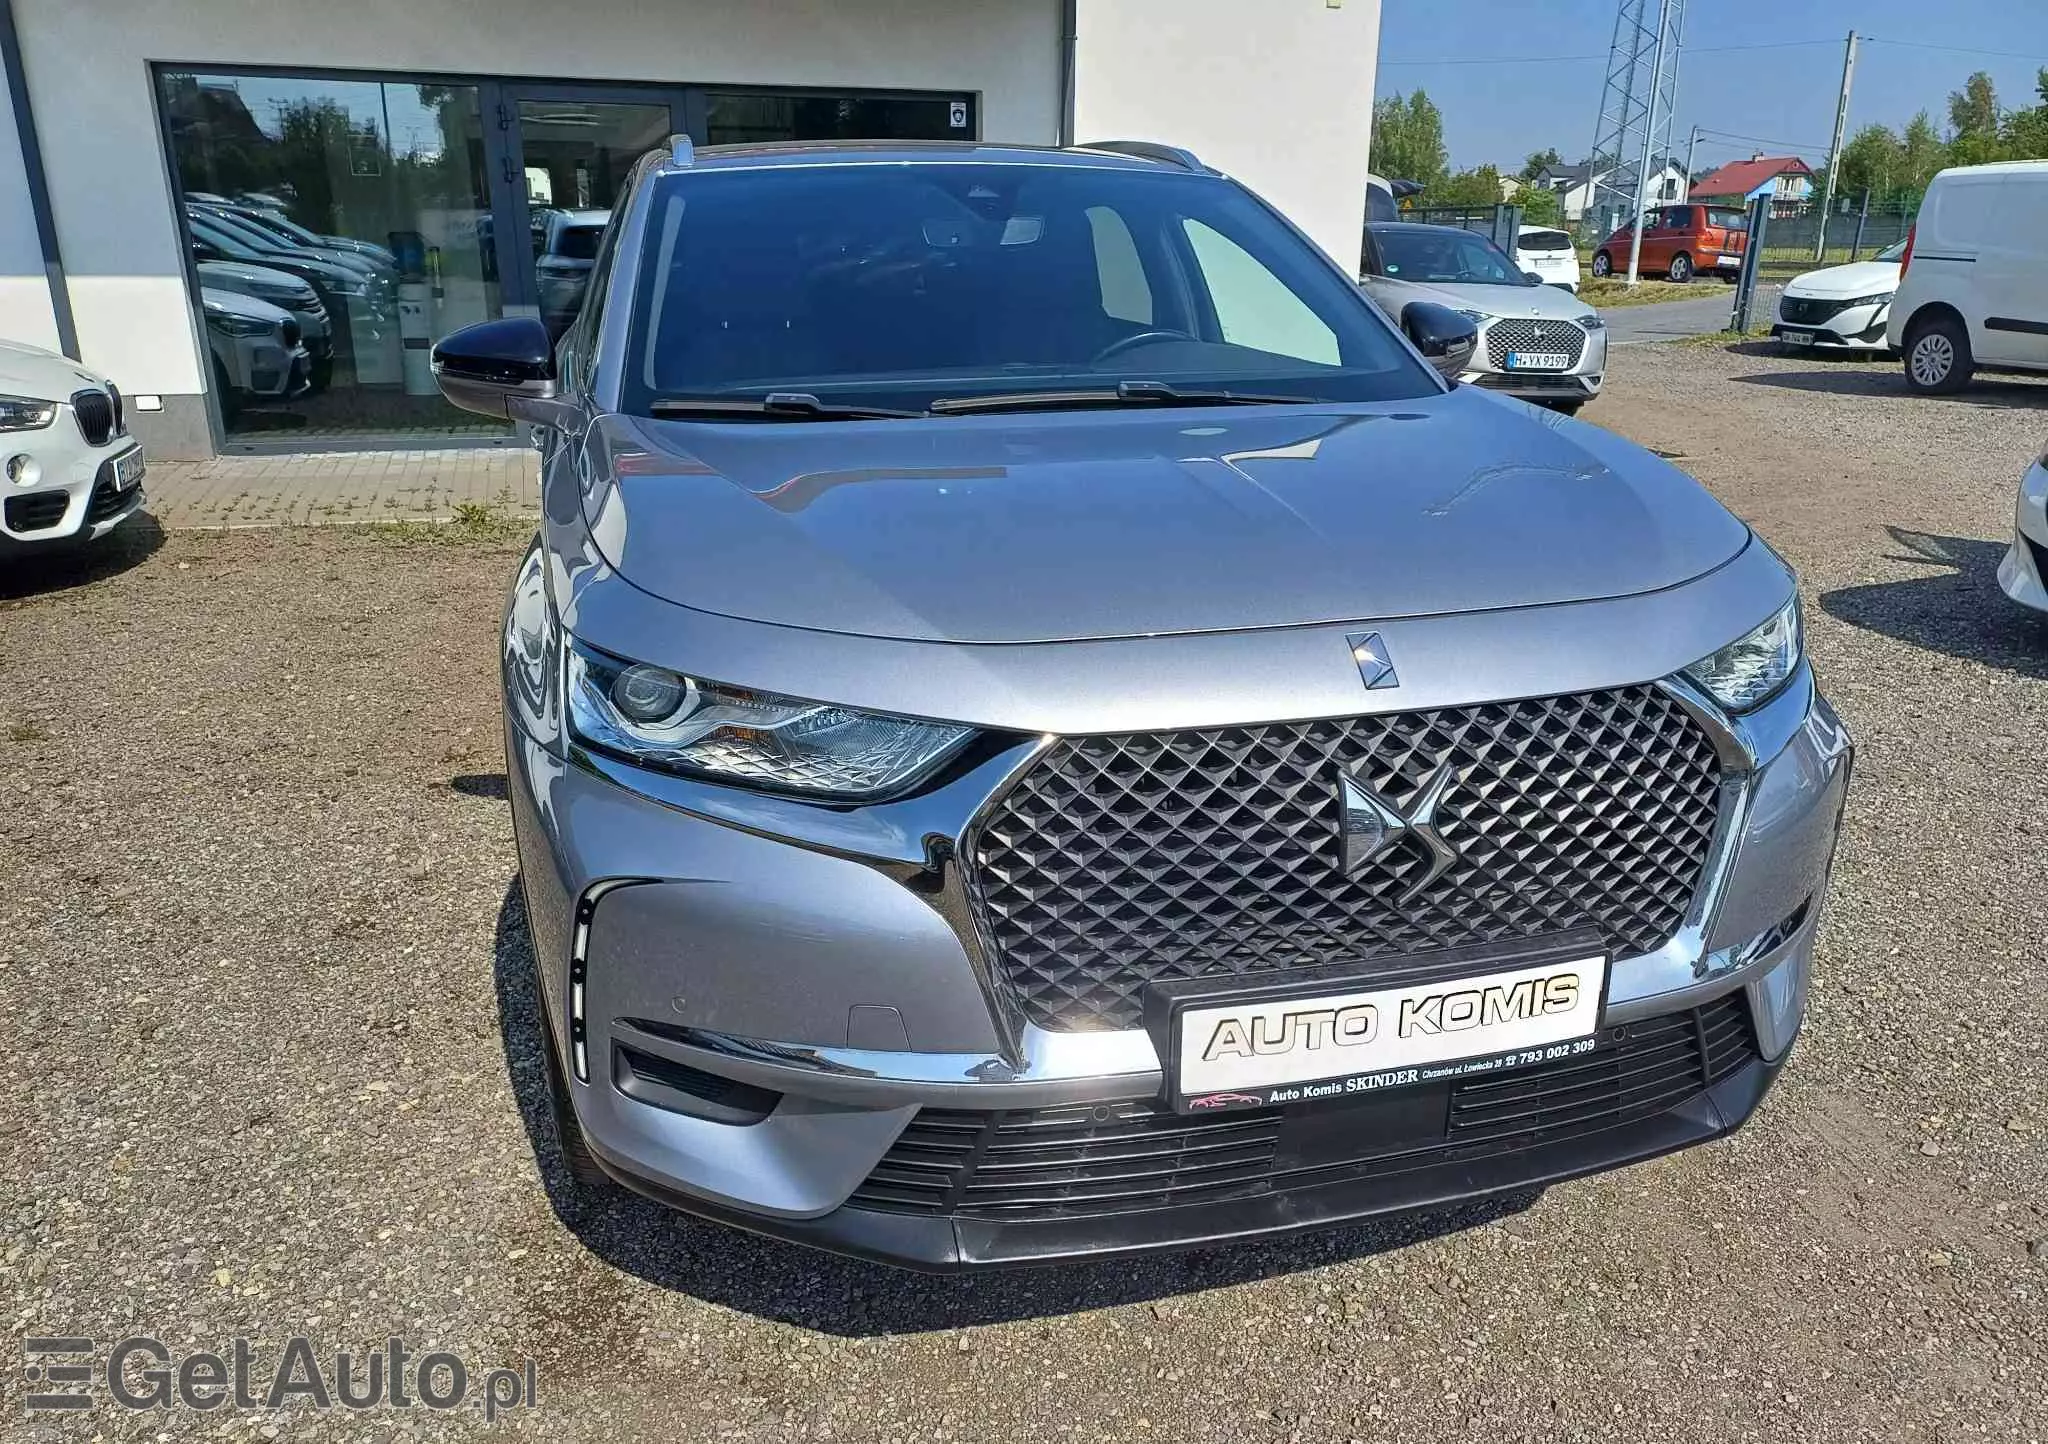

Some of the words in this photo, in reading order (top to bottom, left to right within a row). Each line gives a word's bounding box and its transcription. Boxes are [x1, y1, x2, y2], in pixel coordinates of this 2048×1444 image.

[1201, 1003, 1379, 1061] AUTO
[1398, 973, 1580, 1039] KOMIS
[1269, 1090, 1300, 1103] Auto
[1303, 1083, 1342, 1098] Komis
[1346, 1069, 1419, 1092] SKINDER
[1422, 1066, 1454, 1079] Chrzanów
[1519, 1049, 1543, 1064] 793
[1546, 1044, 1569, 1059] 002
[1572, 1039, 1595, 1054] 309
